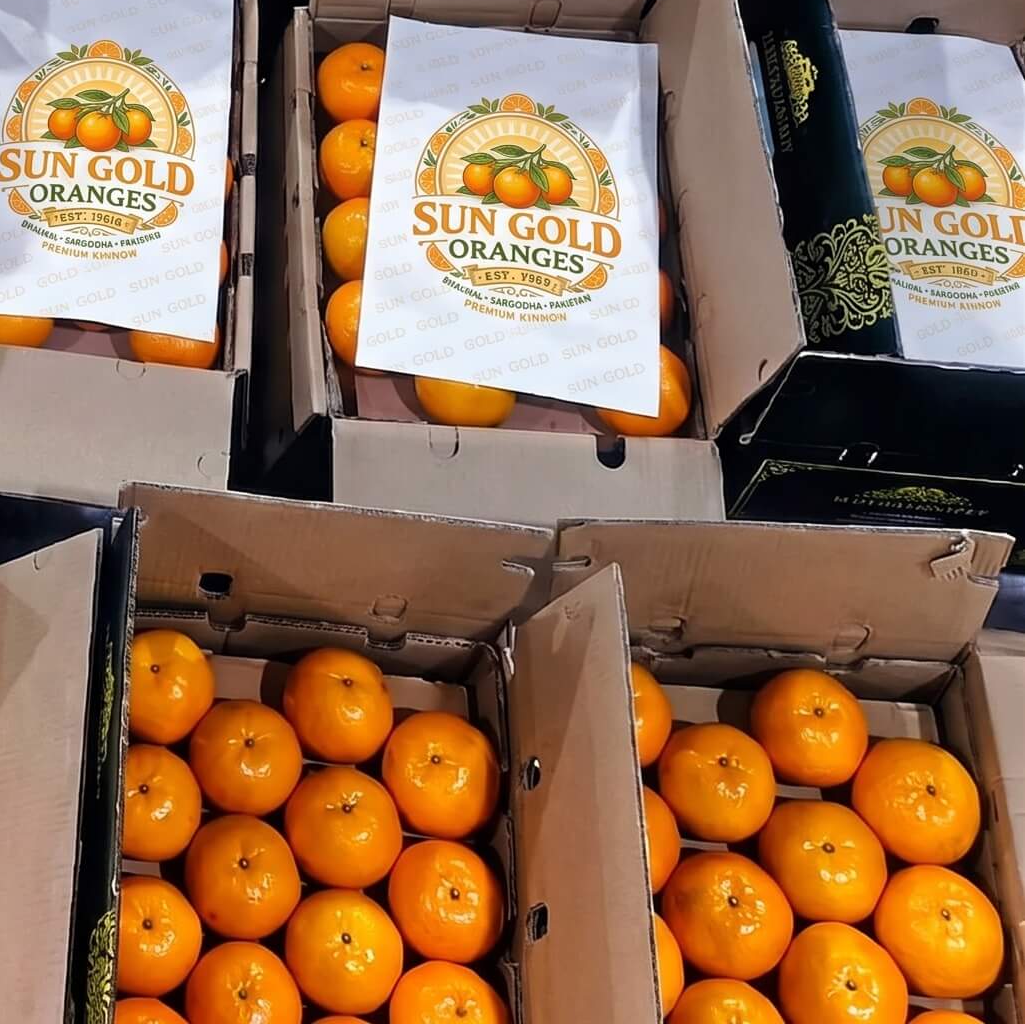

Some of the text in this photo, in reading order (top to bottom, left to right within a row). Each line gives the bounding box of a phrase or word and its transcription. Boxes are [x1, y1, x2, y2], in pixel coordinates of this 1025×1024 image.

[88, 155, 195, 196] GOLD
[29, 183, 156, 212] ORANGES
[413, 201, 622, 258] SUN GOLD
[877, 206, 924, 234] UN
[449, 239, 584, 274] ORANGES
[884, 237, 1010, 264] ORANGES
[490, 296, 543, 311] SARGODHA
